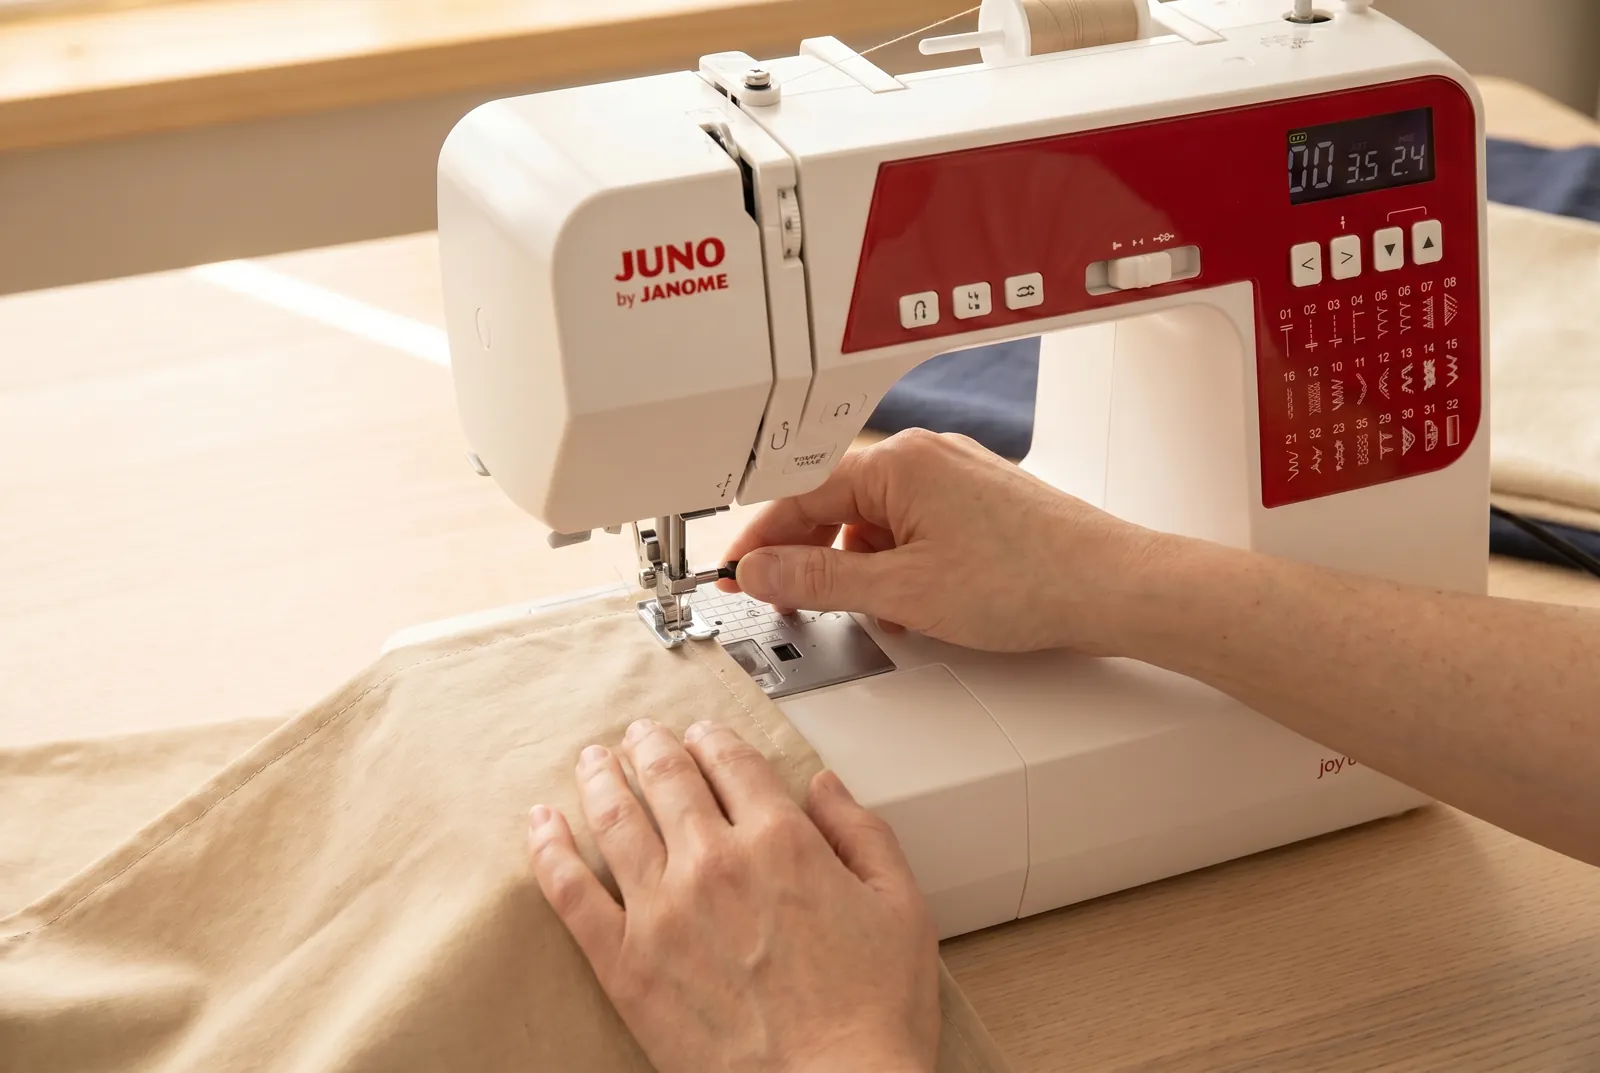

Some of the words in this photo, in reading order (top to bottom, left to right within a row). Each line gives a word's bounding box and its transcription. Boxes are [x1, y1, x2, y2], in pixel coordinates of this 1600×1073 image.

[1288, 141, 1334, 193] 00
[1346, 150, 1378, 184] 3.5
[1391, 144, 1425, 177] 2.4
[614, 236, 726, 282] JUNO
[616, 291, 636, 309] by
[640, 273, 729, 303] JANOME
[1279, 309, 1292, 320] 01
[1303, 304, 1317, 315] 02
[1327, 299, 1340, 311] 03
[1351, 294, 1363, 306] 04
[1374, 290, 1388, 301] 05
[1398, 285, 1411, 297] 06
[1420, 281, 1433, 293] 07
[1443, 276, 1457, 288] 08
[1283, 371, 1296, 382] 16
[1307, 366, 1319, 377] 12
[1331, 361, 1343, 372] 10
[1354, 357, 1365, 368] 11
[1378, 352, 1390, 363] 12
[1401, 348, 1413, 359] 13
[1423, 343, 1435, 354] 14
[1446, 338, 1458, 350] 15
[1285, 433, 1297, 444] 21
[1309, 428, 1322, 439] 32
[1332, 423, 1345, 434] 23
[1356, 418, 1368, 429] 35
[1379, 413, 1392, 425] 29
[1402, 408, 1414, 420] 30
[1424, 403, 1435, 415] 31
[1446, 399, 1459, 410] 32
